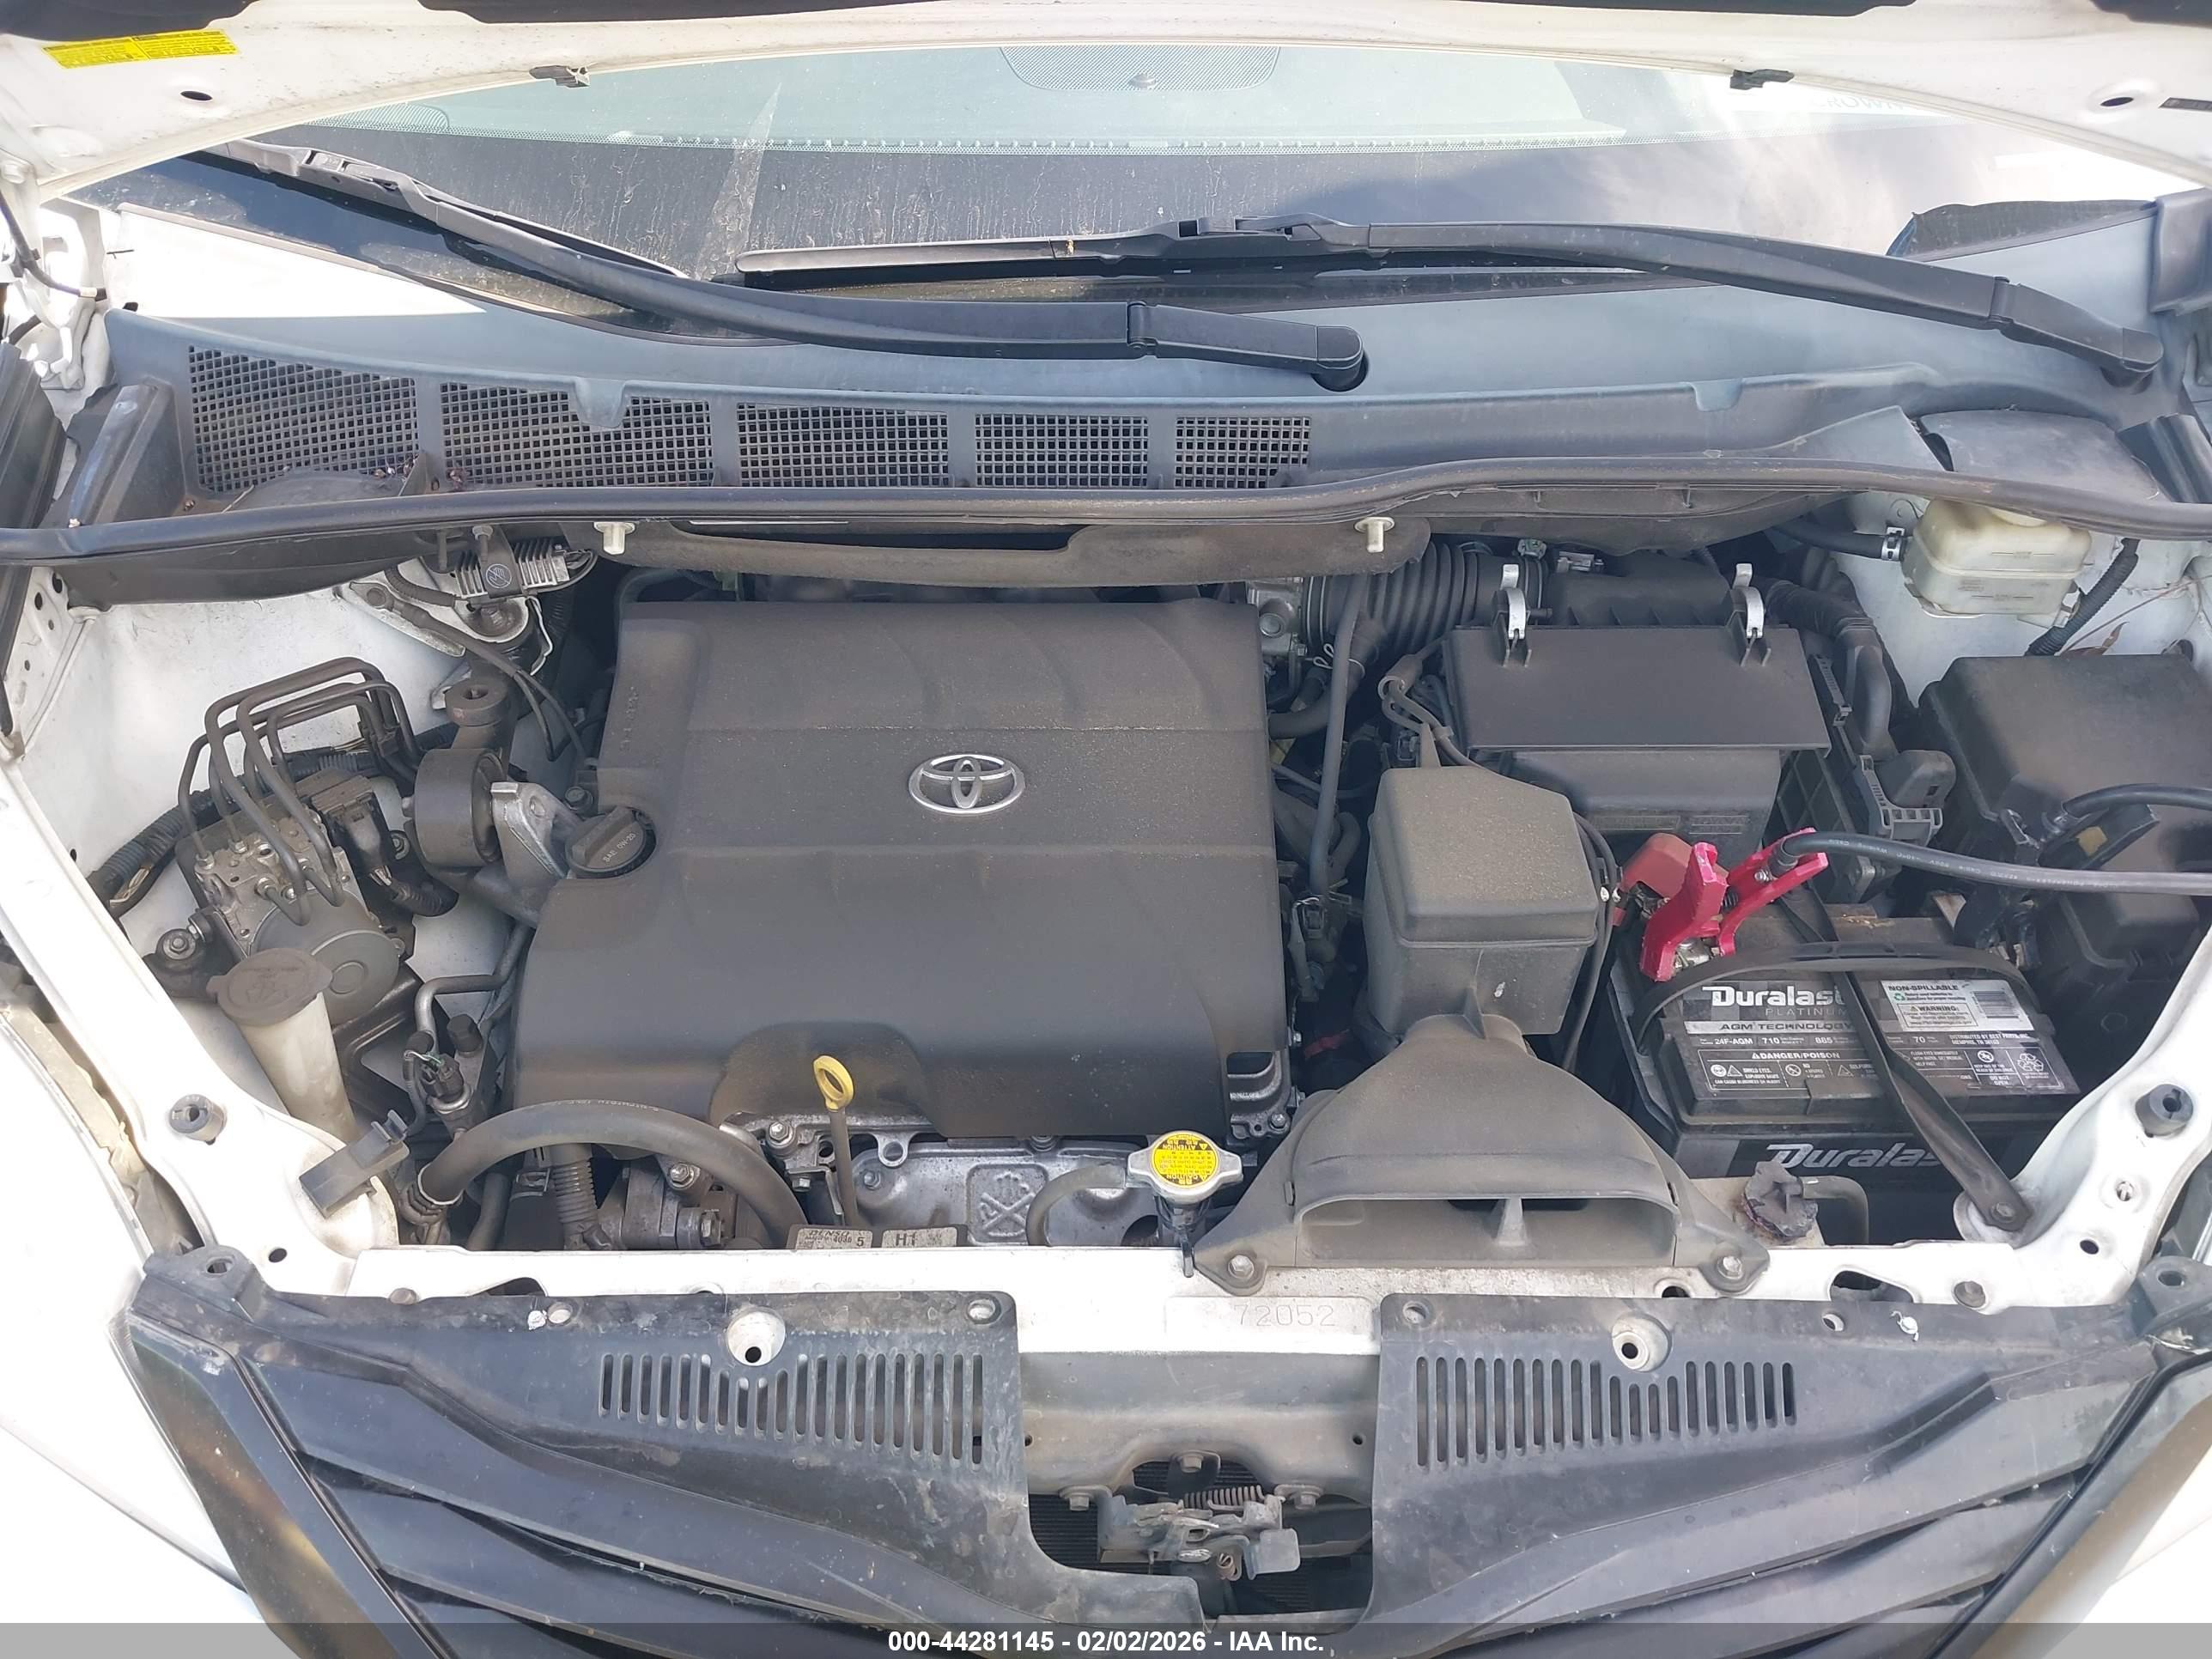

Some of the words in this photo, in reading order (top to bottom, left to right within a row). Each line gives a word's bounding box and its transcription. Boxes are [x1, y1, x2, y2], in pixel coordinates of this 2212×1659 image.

[603, 850, 617, 862] SAE
[1702, 986, 1845, 1006] Duralast
[1766, 1143, 1941, 1168] Duralas
[857, 1237, 865, 1247] 5
[1234, 1304, 1335, 1327] 72052
